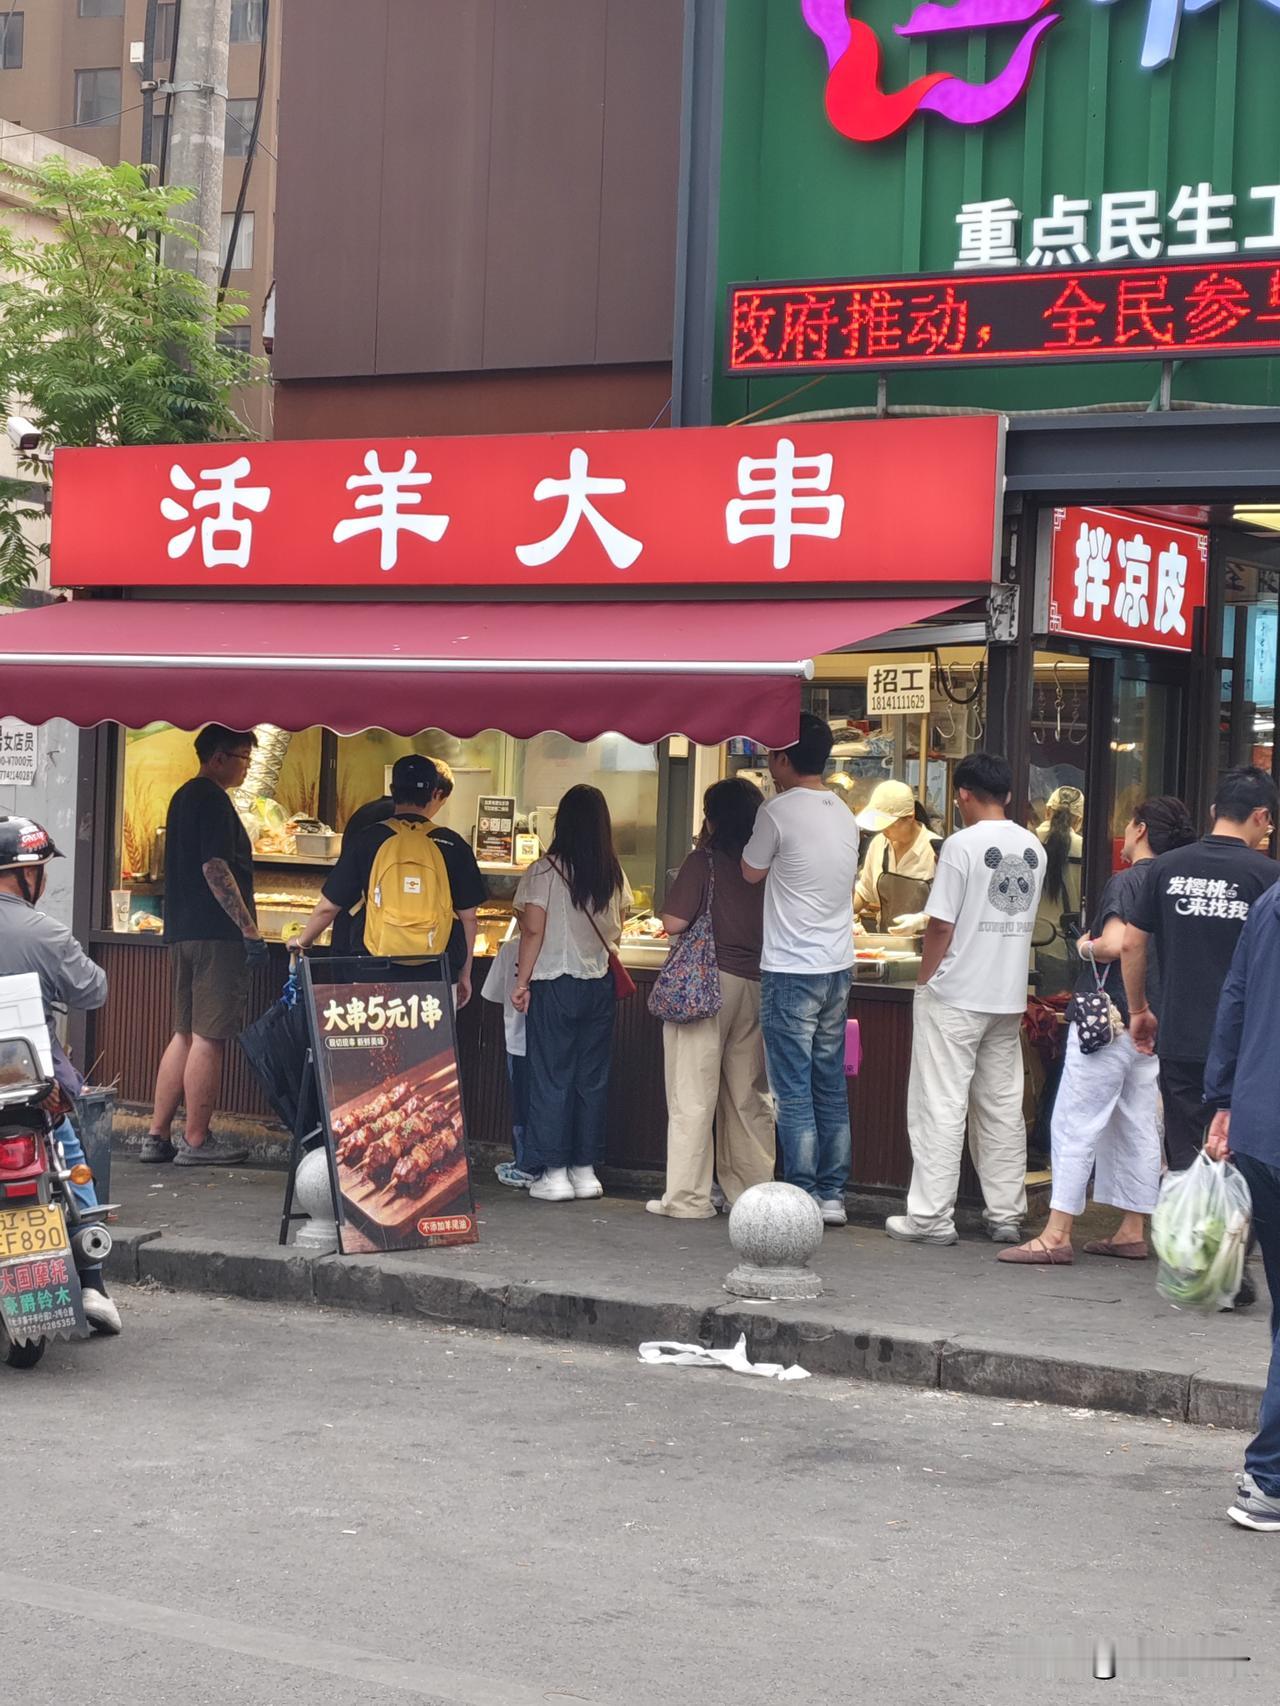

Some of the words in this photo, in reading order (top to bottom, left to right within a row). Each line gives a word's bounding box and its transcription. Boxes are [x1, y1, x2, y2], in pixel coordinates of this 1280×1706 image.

[160, 437, 846, 570] 活羊大串
[1073, 522, 1188, 636] 拌凉皮
[873, 668, 924, 694] 招工
[872, 694, 925, 711] 18141111629
[0, 725, 34, 752] 女店员
[1166, 876, 1229, 898] 发樱桃
[1175, 897, 1249, 921] 来找我
[323, 994, 443, 1033] 大串5元1串
